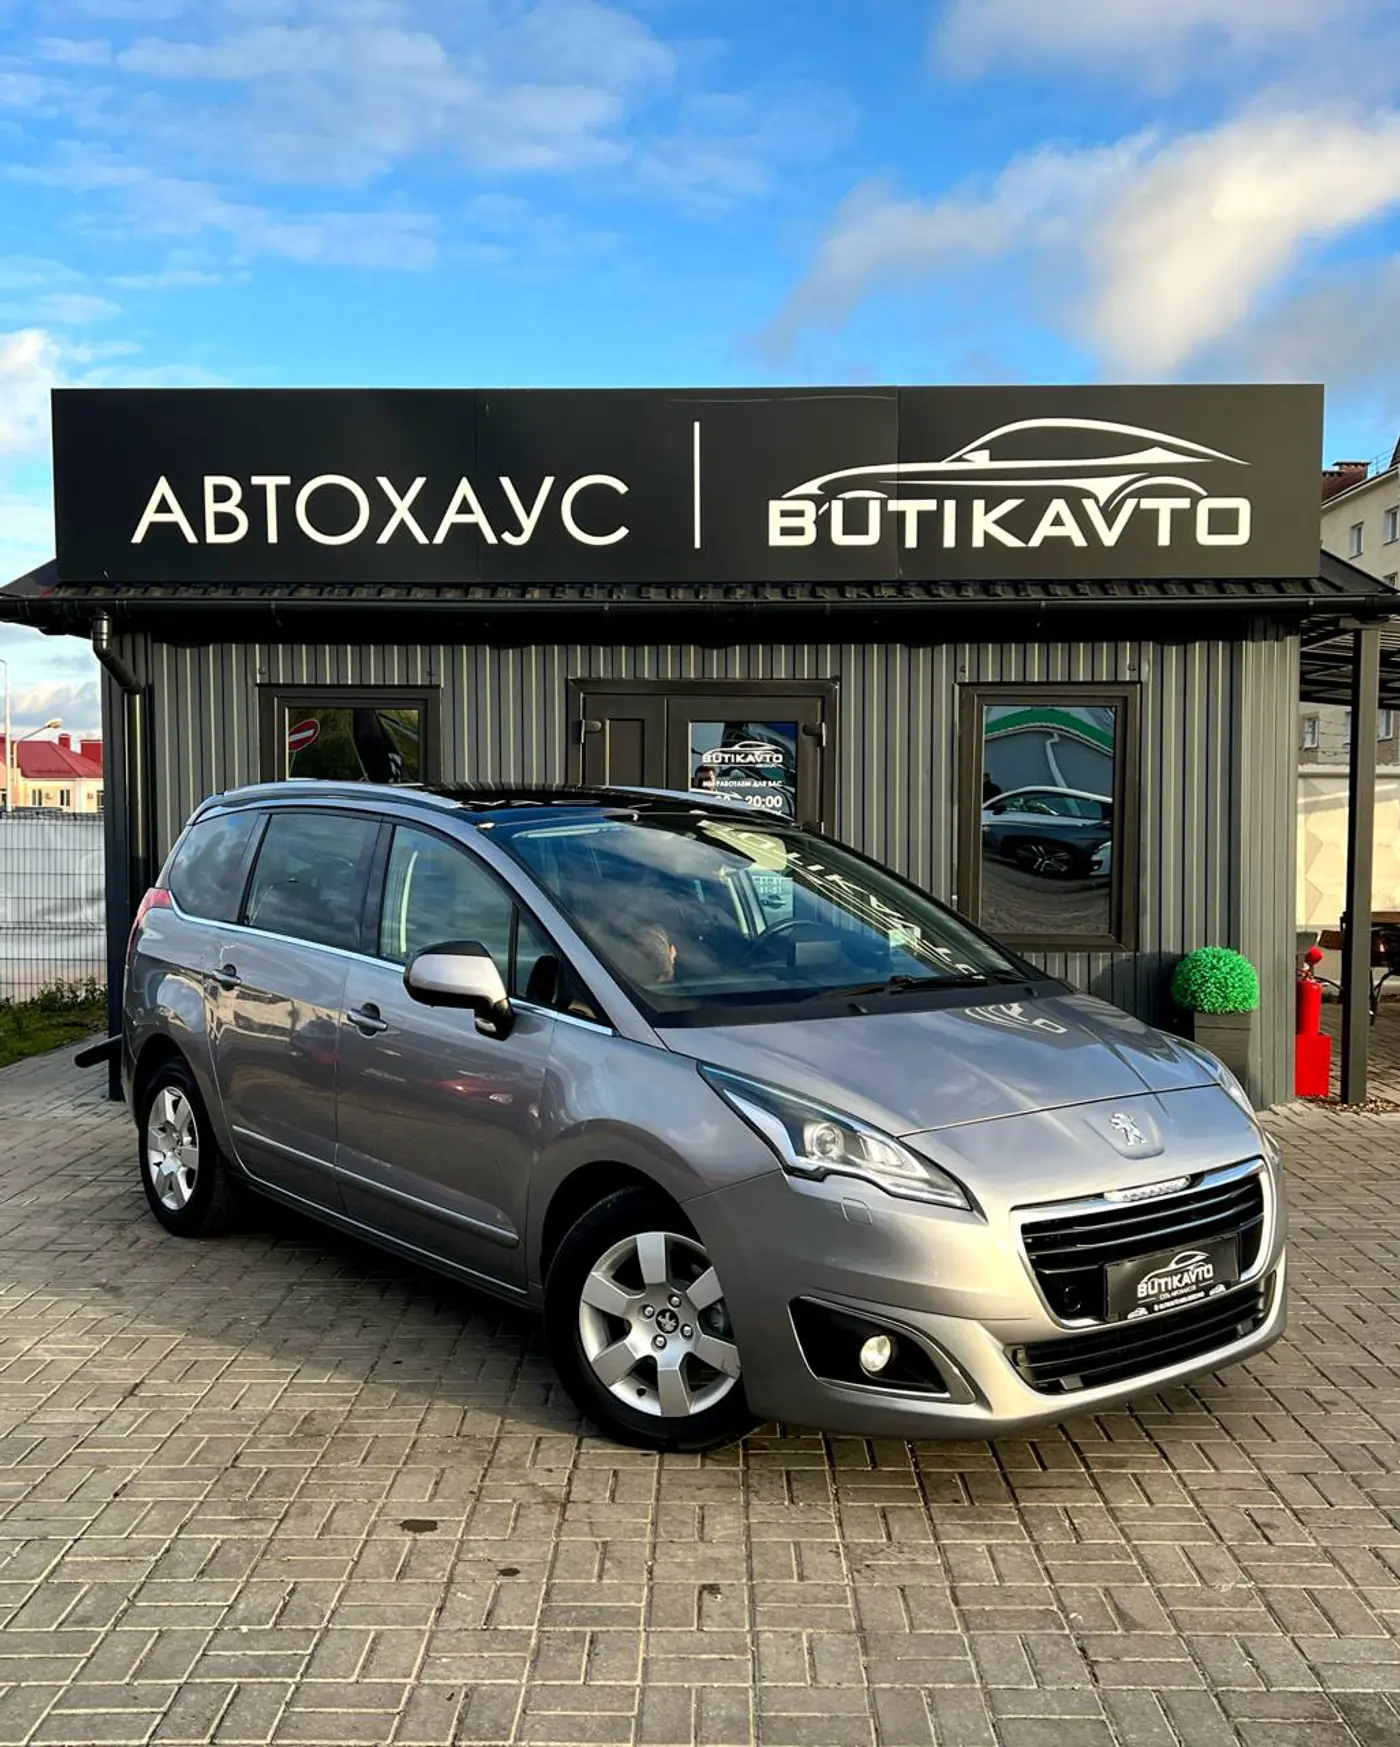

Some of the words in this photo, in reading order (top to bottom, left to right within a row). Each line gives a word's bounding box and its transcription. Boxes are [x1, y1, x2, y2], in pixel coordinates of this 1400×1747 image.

[131, 473, 631, 546] АВТОХАУС
[767, 495, 1251, 549] BUTIKAVTO
[702, 753, 783, 763] BUTIKAVTO
[745, 795, 783, 808] 20:00
[1136, 1263, 1214, 1298] BUTIKAVTO
